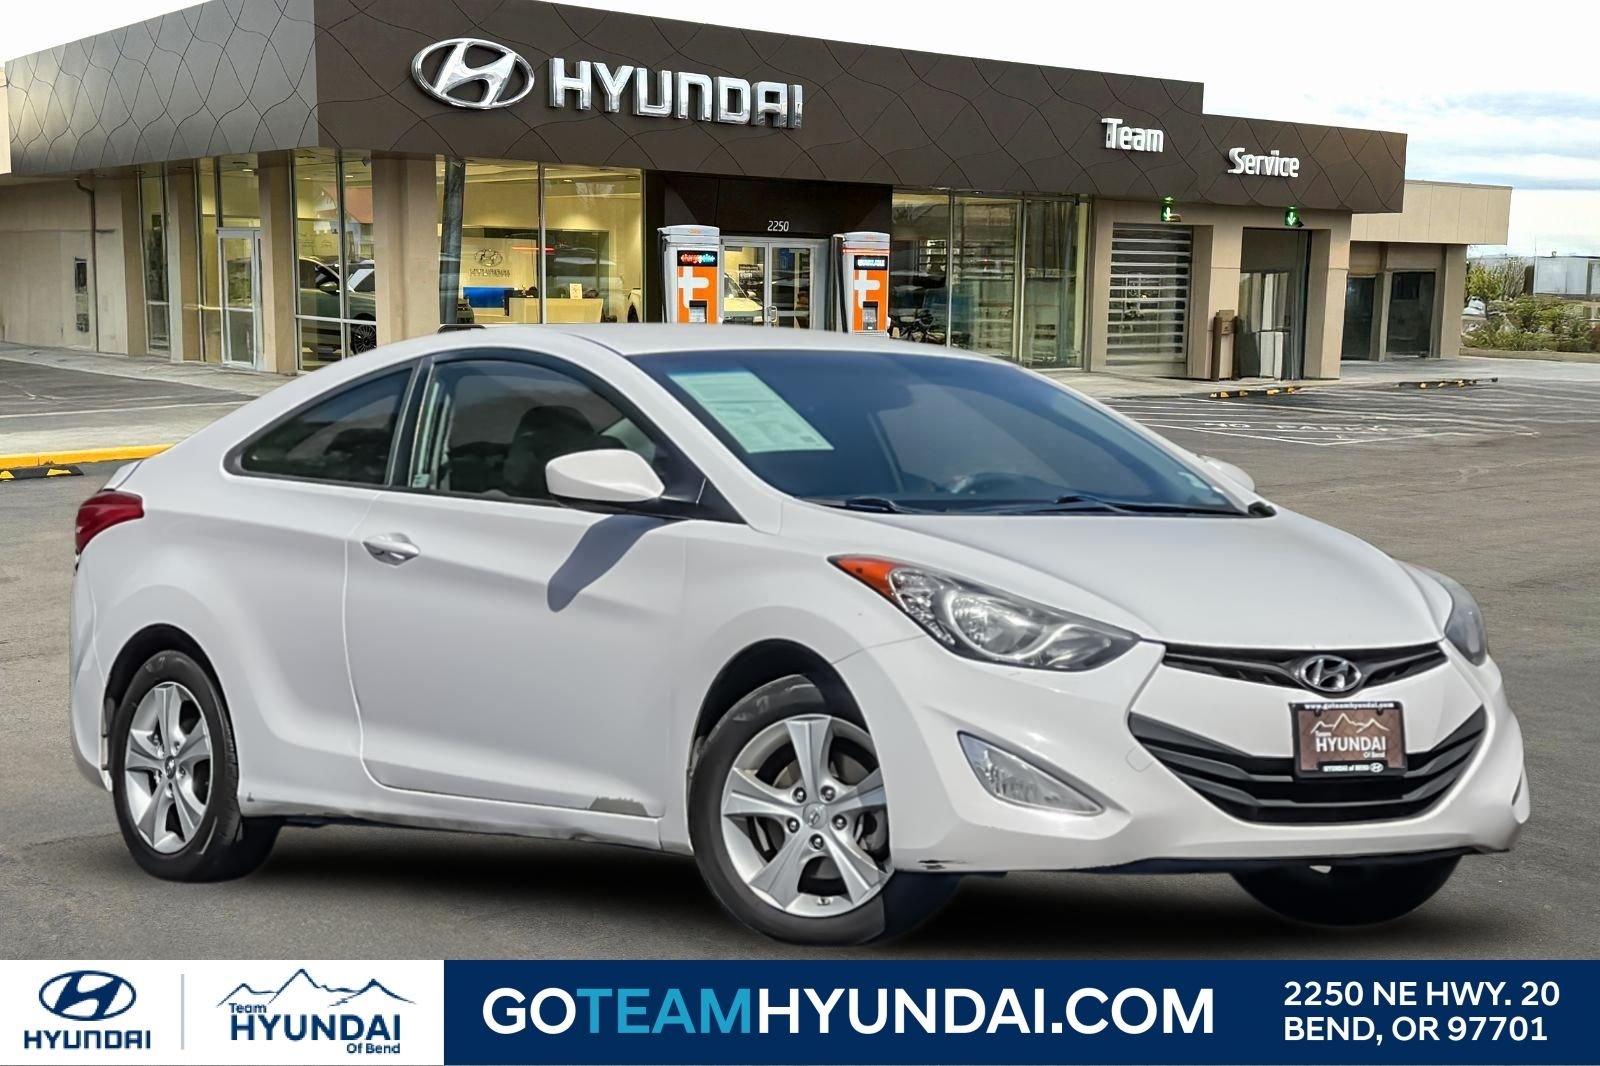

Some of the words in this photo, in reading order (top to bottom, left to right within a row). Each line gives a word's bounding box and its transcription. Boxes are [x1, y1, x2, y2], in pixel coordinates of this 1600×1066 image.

[548, 57, 804, 129] HYUNDAI
[1101, 117, 1164, 152] Team
[1227, 147, 1300, 178] Service
[767, 220, 790, 232] 2250
[1315, 735, 1387, 752] HYUNDAI
